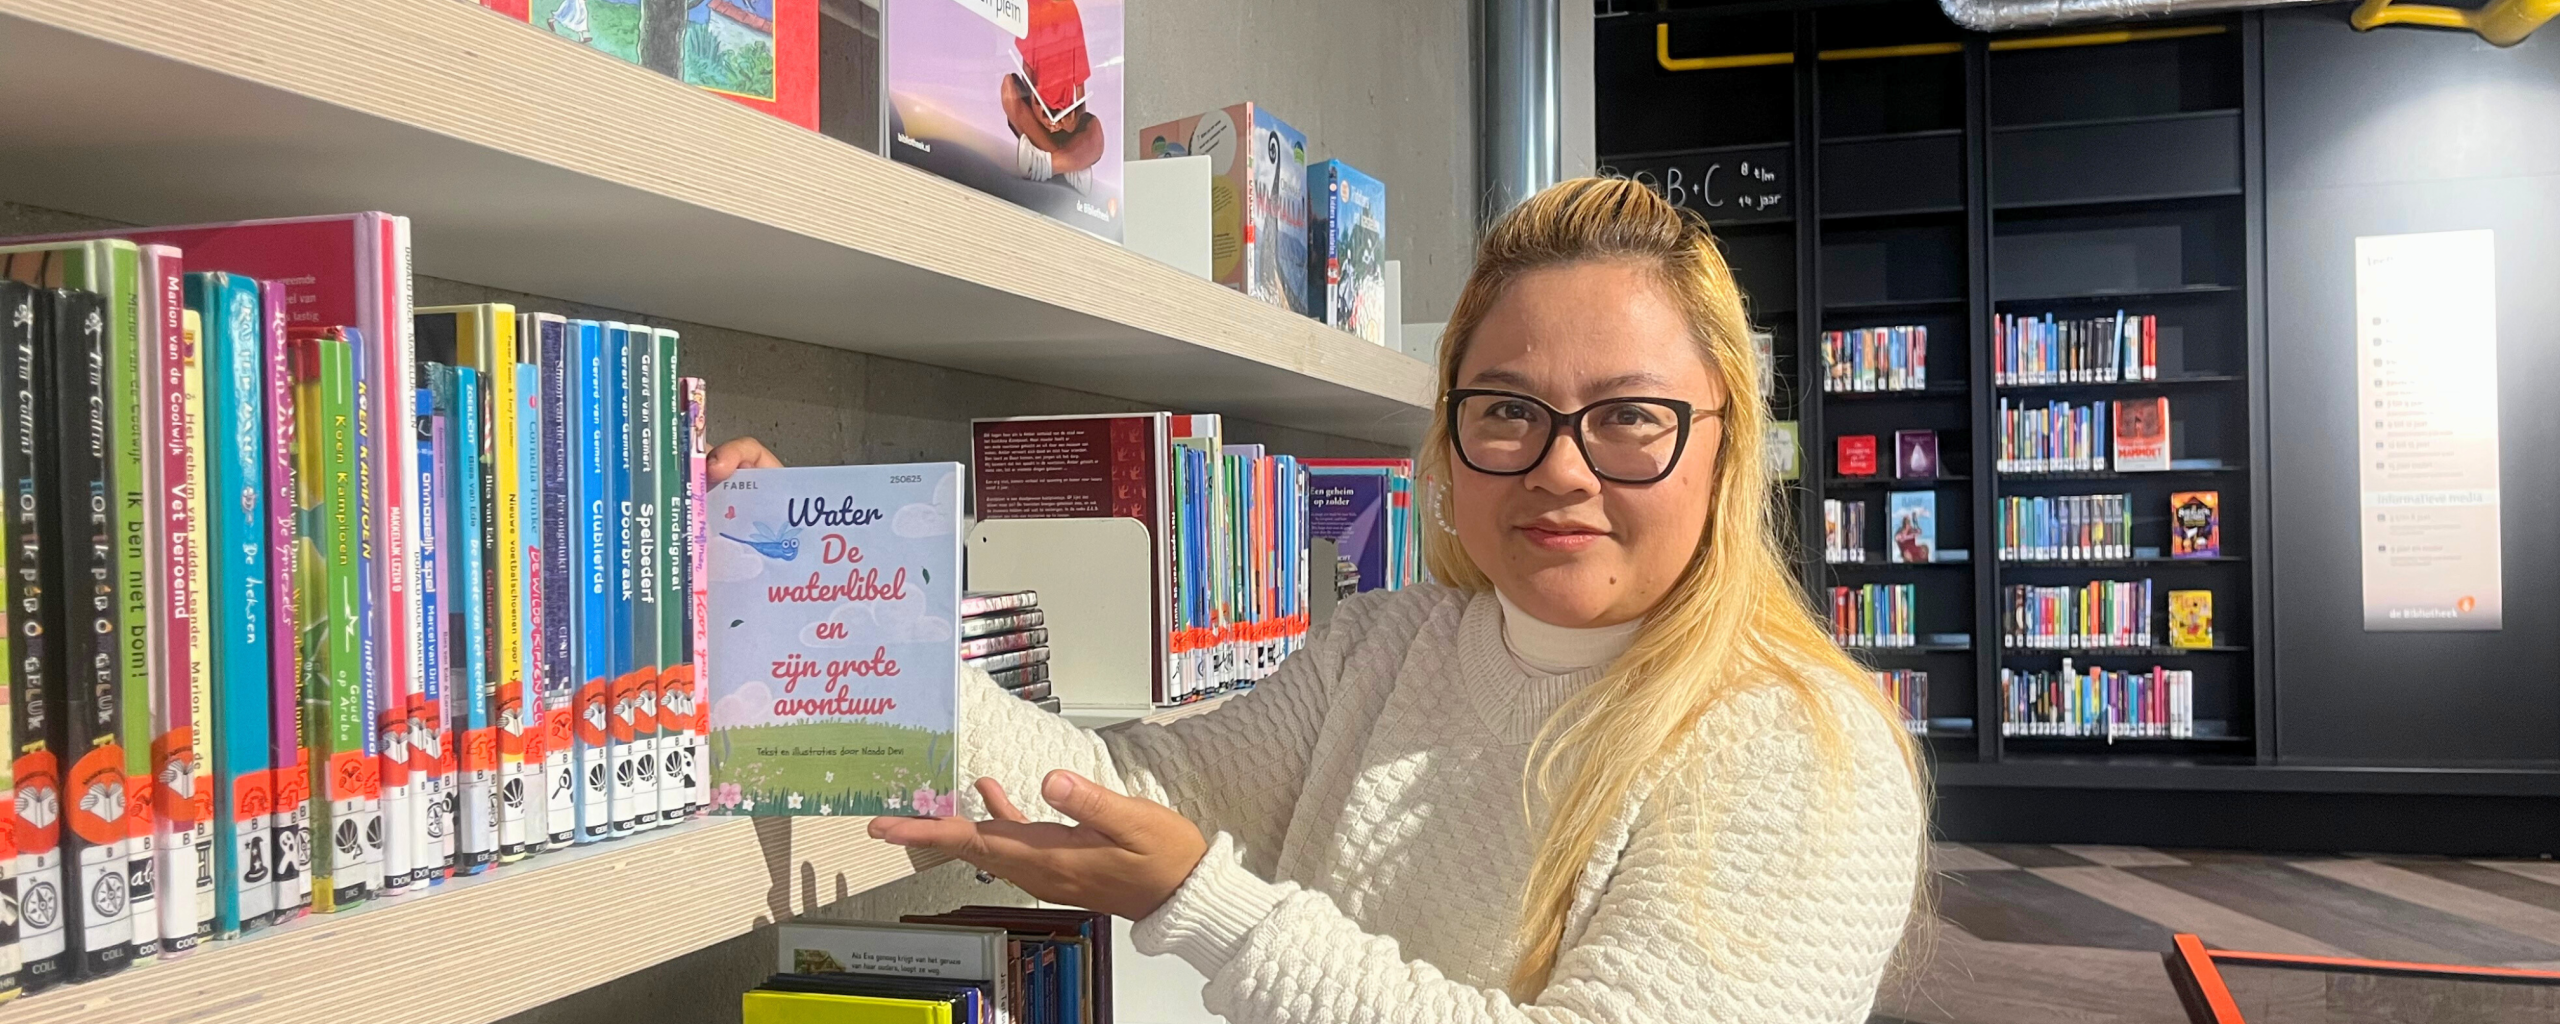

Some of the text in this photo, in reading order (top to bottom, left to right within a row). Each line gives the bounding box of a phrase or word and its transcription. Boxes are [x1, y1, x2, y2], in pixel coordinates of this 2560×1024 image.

[1704, 163, 1724, 207] C
[1756, 193, 1782, 211] jaar
[404, 247, 413, 291] DONALD
[406, 294, 414, 324] DUCK
[168, 277, 183, 456] Marion van de Coolwijk
[670, 355, 678, 393] Gerard
[19, 390, 33, 455] Collins
[90, 396, 105, 459] Collins
[592, 357, 603, 474] Gerard van Gemert
[621, 346, 632, 469] Gerard van Gemert
[641, 355, 652, 472] Gerard van Gemert
[671, 418, 679, 455] Gemert
[334, 415, 350, 566] Koen Kampioen
[359, 445, 372, 560] KAMPIOEN
[467, 455, 478, 528] Bies van Ede
[723, 481, 759, 490] FABEL
[1313, 497, 1350, 508] op zolder
[1325, 487, 1354, 497] geheim
[185, 414, 201, 650] Het geheim van ridder Leander
[290, 513, 300, 536] van
[485, 475, 495, 549] Bies van Ede
[787, 495, 883, 528] Water
[172, 484, 189, 619] Vet beroemd
[291, 540, 301, 573] Dam
[391, 507, 403, 584] MAKKELIJK LEZEN
[593, 500, 605, 594] Clubliefde
[621, 501, 633, 601] Doorbraak
[635, 503, 655, 604] Spelbederf
[668, 496, 682, 591] Eindsignaal
[821, 533, 864, 565] De
[128, 492, 149, 679] Ik ben niet bom!
[243, 543, 263, 645] De heksen
[276, 516, 293, 627] De griezels
[413, 551, 423, 628] DONALD DUCK
[507, 493, 519, 664] Nieuwe voetbalschoenen voor
[768, 567, 907, 604] waterlibel
[426, 605, 438, 695] Marcel van Driel
[470, 539, 486, 715] De bende van het kerkhof
[815, 621, 849, 640] en
[771, 645, 901, 694] zijn grote
[191, 662, 205, 770] Marion van de
[337, 670, 351, 741] op Aruba
[350, 685, 361, 722] Goud
[773, 684, 897, 717] avontuur
[756, 747, 778, 756] Tekst
[792, 747, 837, 756] illustraties
[840, 748, 858, 756] door
[144, 837, 151, 849] B
[182, 833, 190, 845] B
[197, 823, 205, 835] B
[38, 856, 44, 867] B
[32, 960, 57, 974] COLL
[102, 949, 124, 961] COLL
[176, 937, 197, 949] COO
[1000, 972, 1008, 990] Jan
